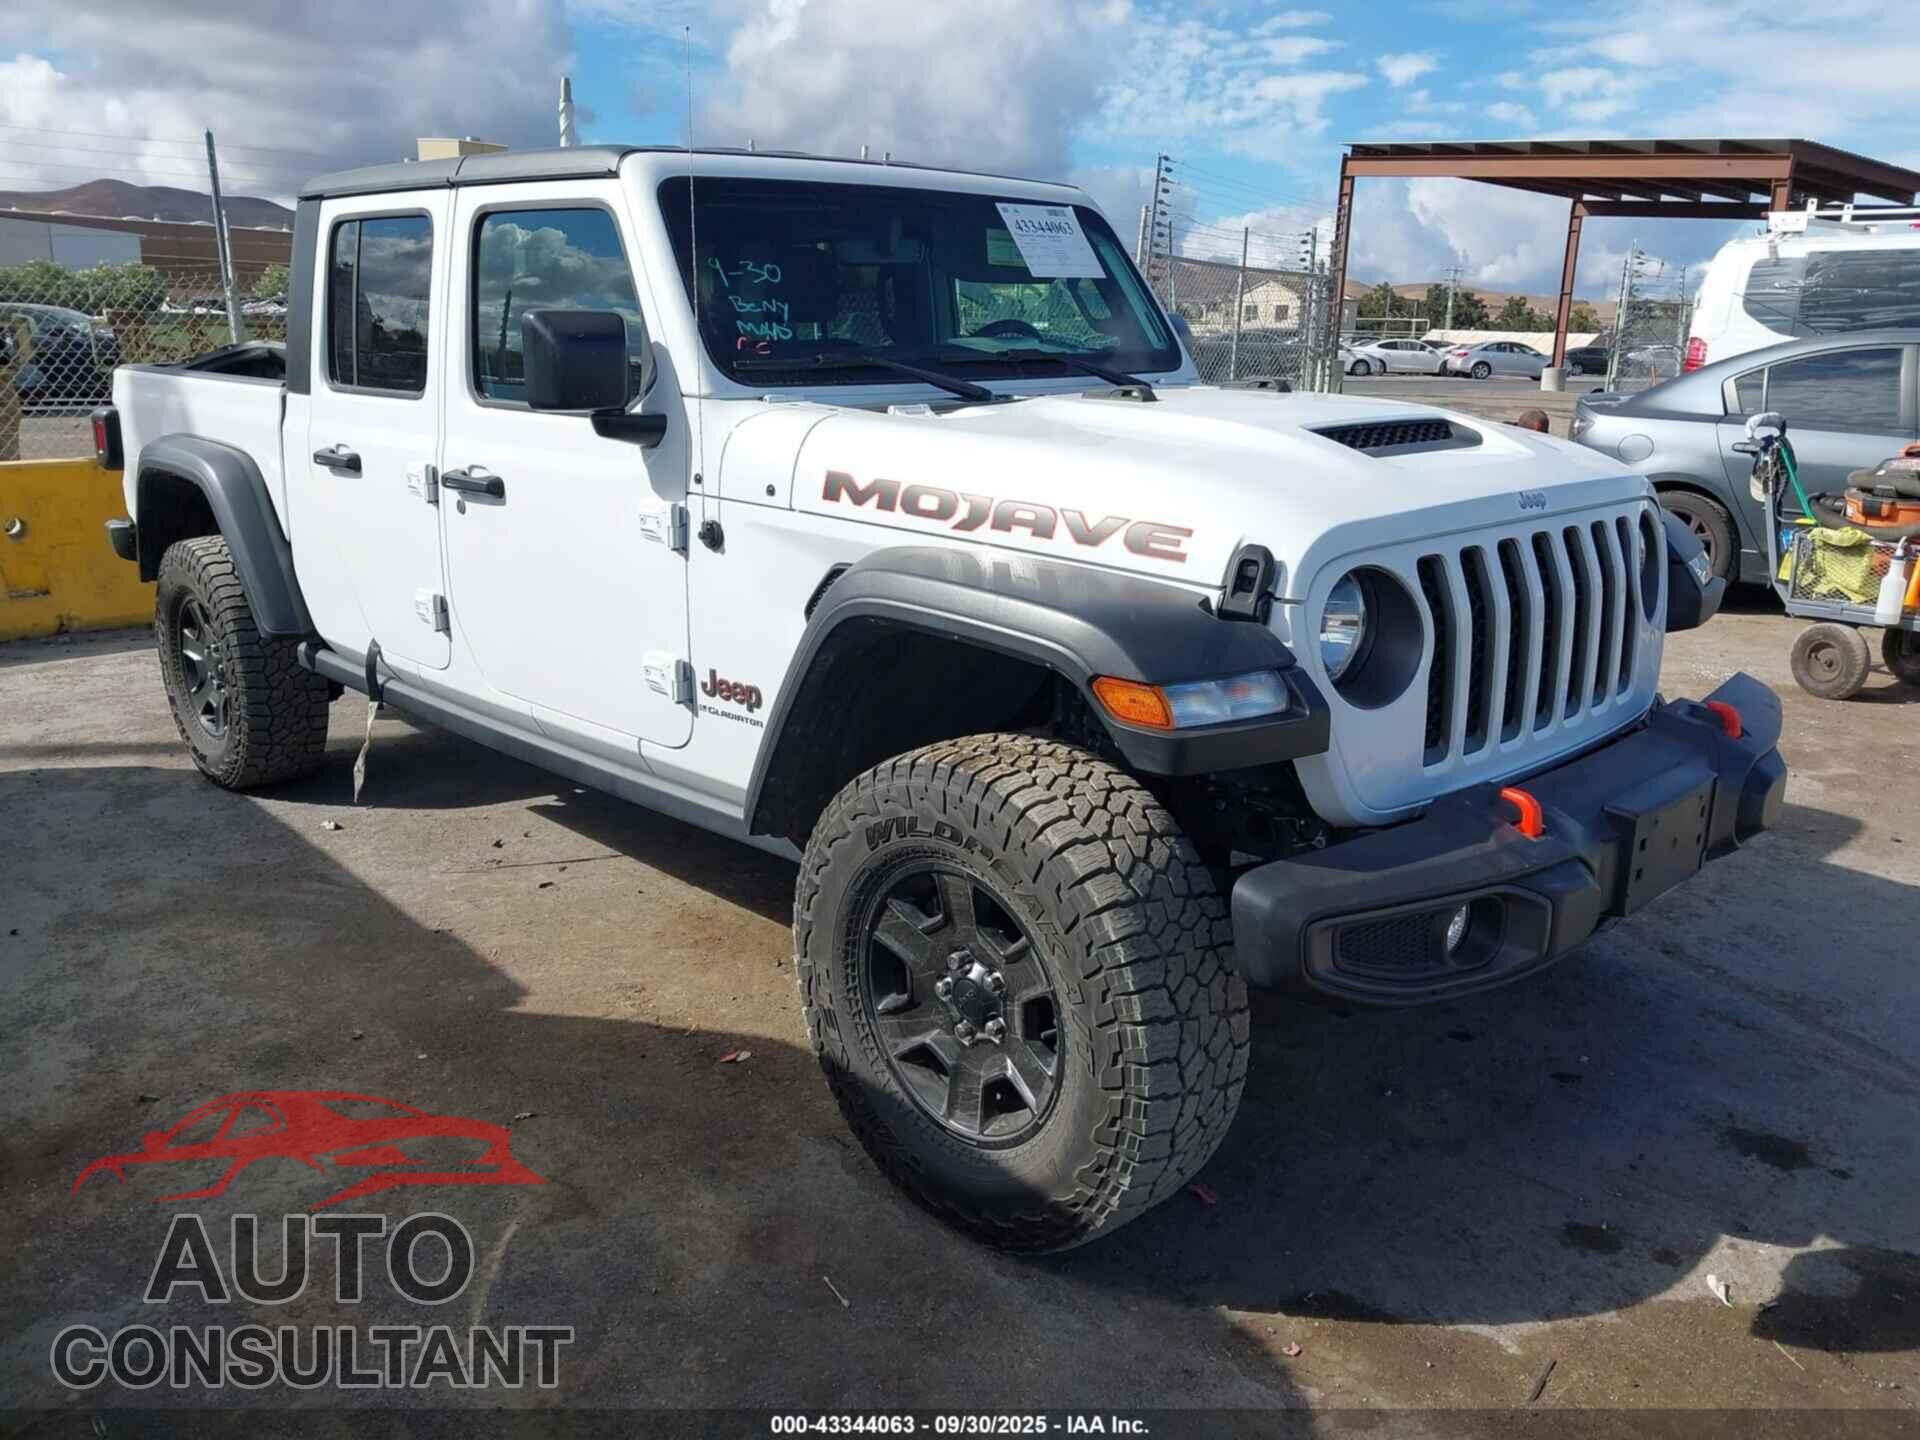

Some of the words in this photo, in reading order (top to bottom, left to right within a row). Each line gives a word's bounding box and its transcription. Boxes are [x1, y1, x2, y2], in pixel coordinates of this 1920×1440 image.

[1015, 219, 1075, 236] 43344063
[707, 257, 781, 287] 9-30
[1518, 490, 1547, 511] Jeep
[822, 469, 1194, 564] MOJAVE
[701, 668, 763, 713] Jeep
